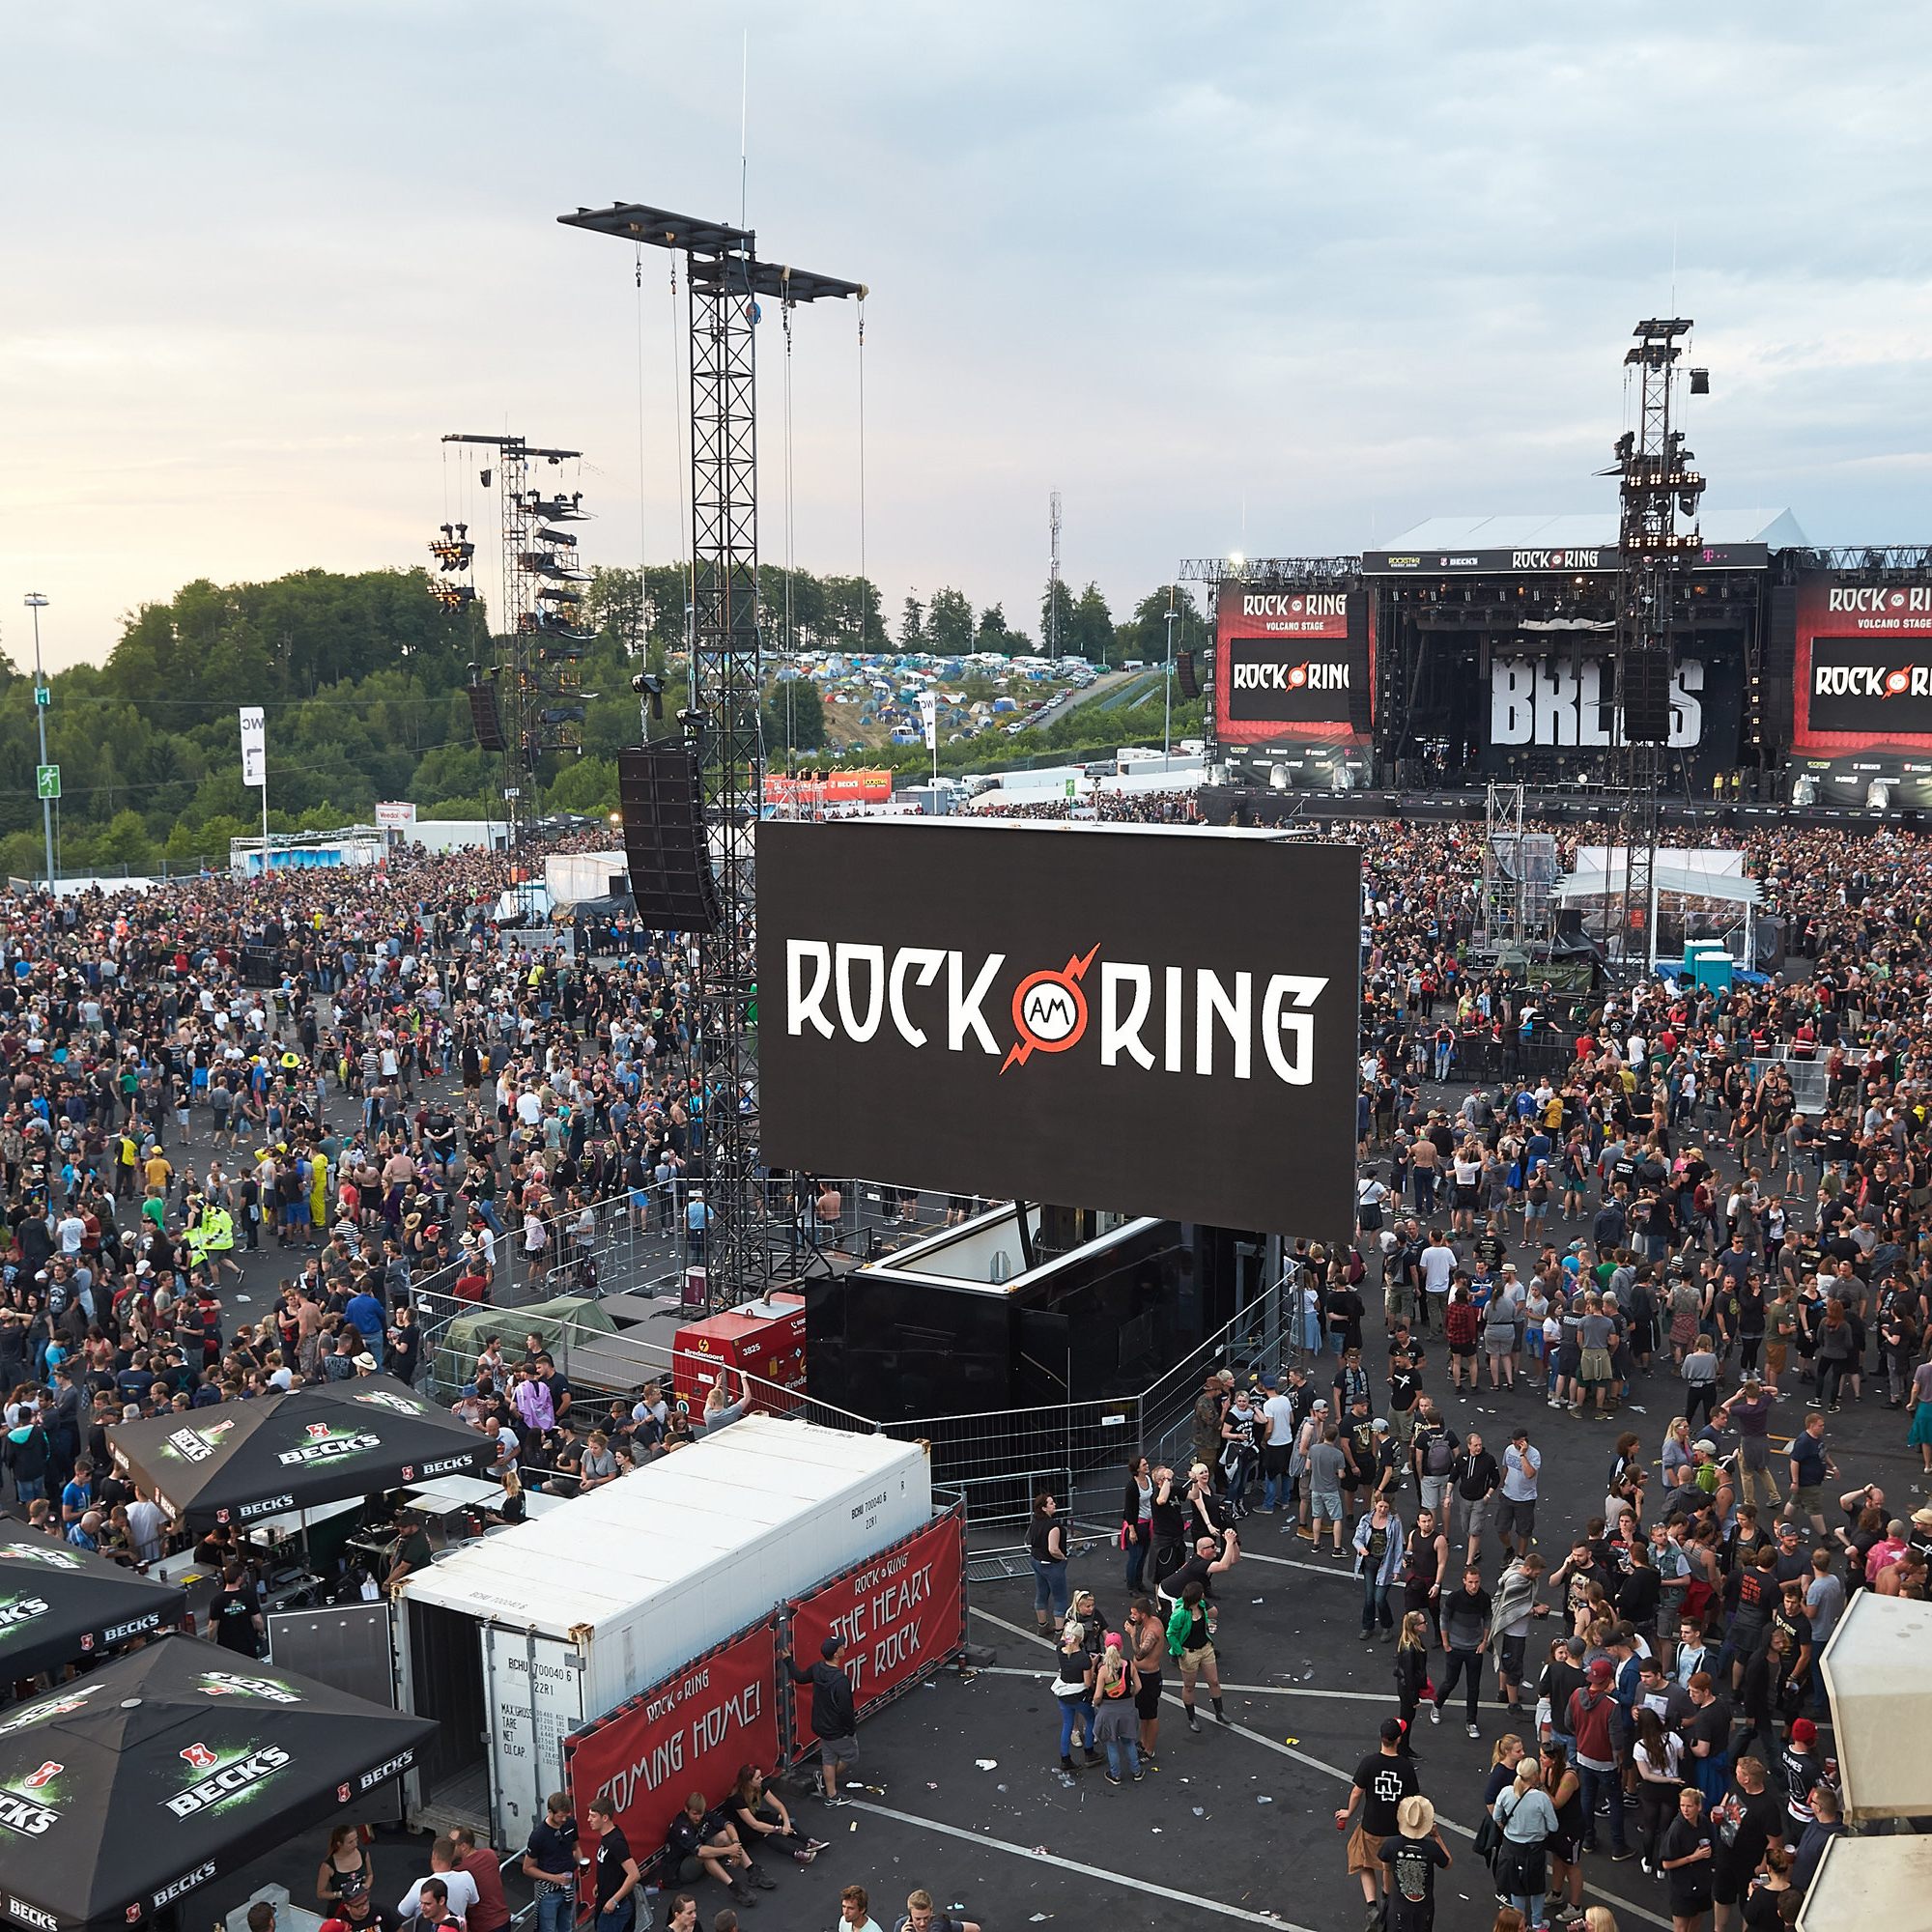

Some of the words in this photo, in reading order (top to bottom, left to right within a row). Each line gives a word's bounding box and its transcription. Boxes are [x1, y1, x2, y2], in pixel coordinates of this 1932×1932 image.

[1512, 551, 1551, 568] ROCK
[1564, 550, 1600, 568] RING
[1243, 595, 1289, 616] ROCK
[1306, 594, 1348, 616] RING
[1829, 588, 1888, 611] ROCK
[1266, 622, 1298, 631] VOLCANO
[1301, 621, 1324, 631] STAGE
[1858, 618, 1900, 629] VOLCANO
[1903, 618, 1932, 629] STAGE
[1234, 664, 1288, 689] ROCK
[1816, 667, 1887, 696] ROCK
[786, 938, 1007, 1056] ROCK
[1028, 996, 1070, 1027] AM
[1099, 961, 1331, 1087] RING
[684, 1348, 724, 1361] Bredenoord
[742, 1343, 761, 1356] 3825
[169, 1427, 213, 1462] BECK'S
[278, 1434, 382, 1465] BECK'S
[423, 1455, 473, 1475] BECK'S
[239, 1493, 294, 1519] BECK'S
[851, 1504, 864, 1520] BCHU
[865, 1493, 882, 1513] 700040
[883, 1492, 887, 1502] 6
[866, 1515, 877, 1530] 22R1
[855, 1567, 880, 1596] ROCK
[887, 1551, 910, 1577] RING
[829, 1603, 867, 1649] THE
[872, 1562, 932, 1631] HEART
[104, 1614, 159, 1642] BECK'S
[875, 1616, 922, 1677] ROCK
[508, 1658, 528, 1672] BCHU
[533, 1663, 564, 1680] 700040
[566, 1670, 572, 1682] 6
[200, 1672, 302, 1703] BECK'S
[534, 1682, 554, 1695] 22R1
[646, 1690, 675, 1725] ROCK
[684, 1668, 709, 1700] RING
[502, 1717, 517, 1729] TARE
[693, 1681, 761, 1758] HOME!
[502, 1730, 514, 1743] NET
[165, 1744, 292, 1817] BECK'S
[360, 1750, 413, 1789] BECK'S
[153, 1861, 216, 1908] BECK'S
[9, 1897, 58, 1932] BECK'S
